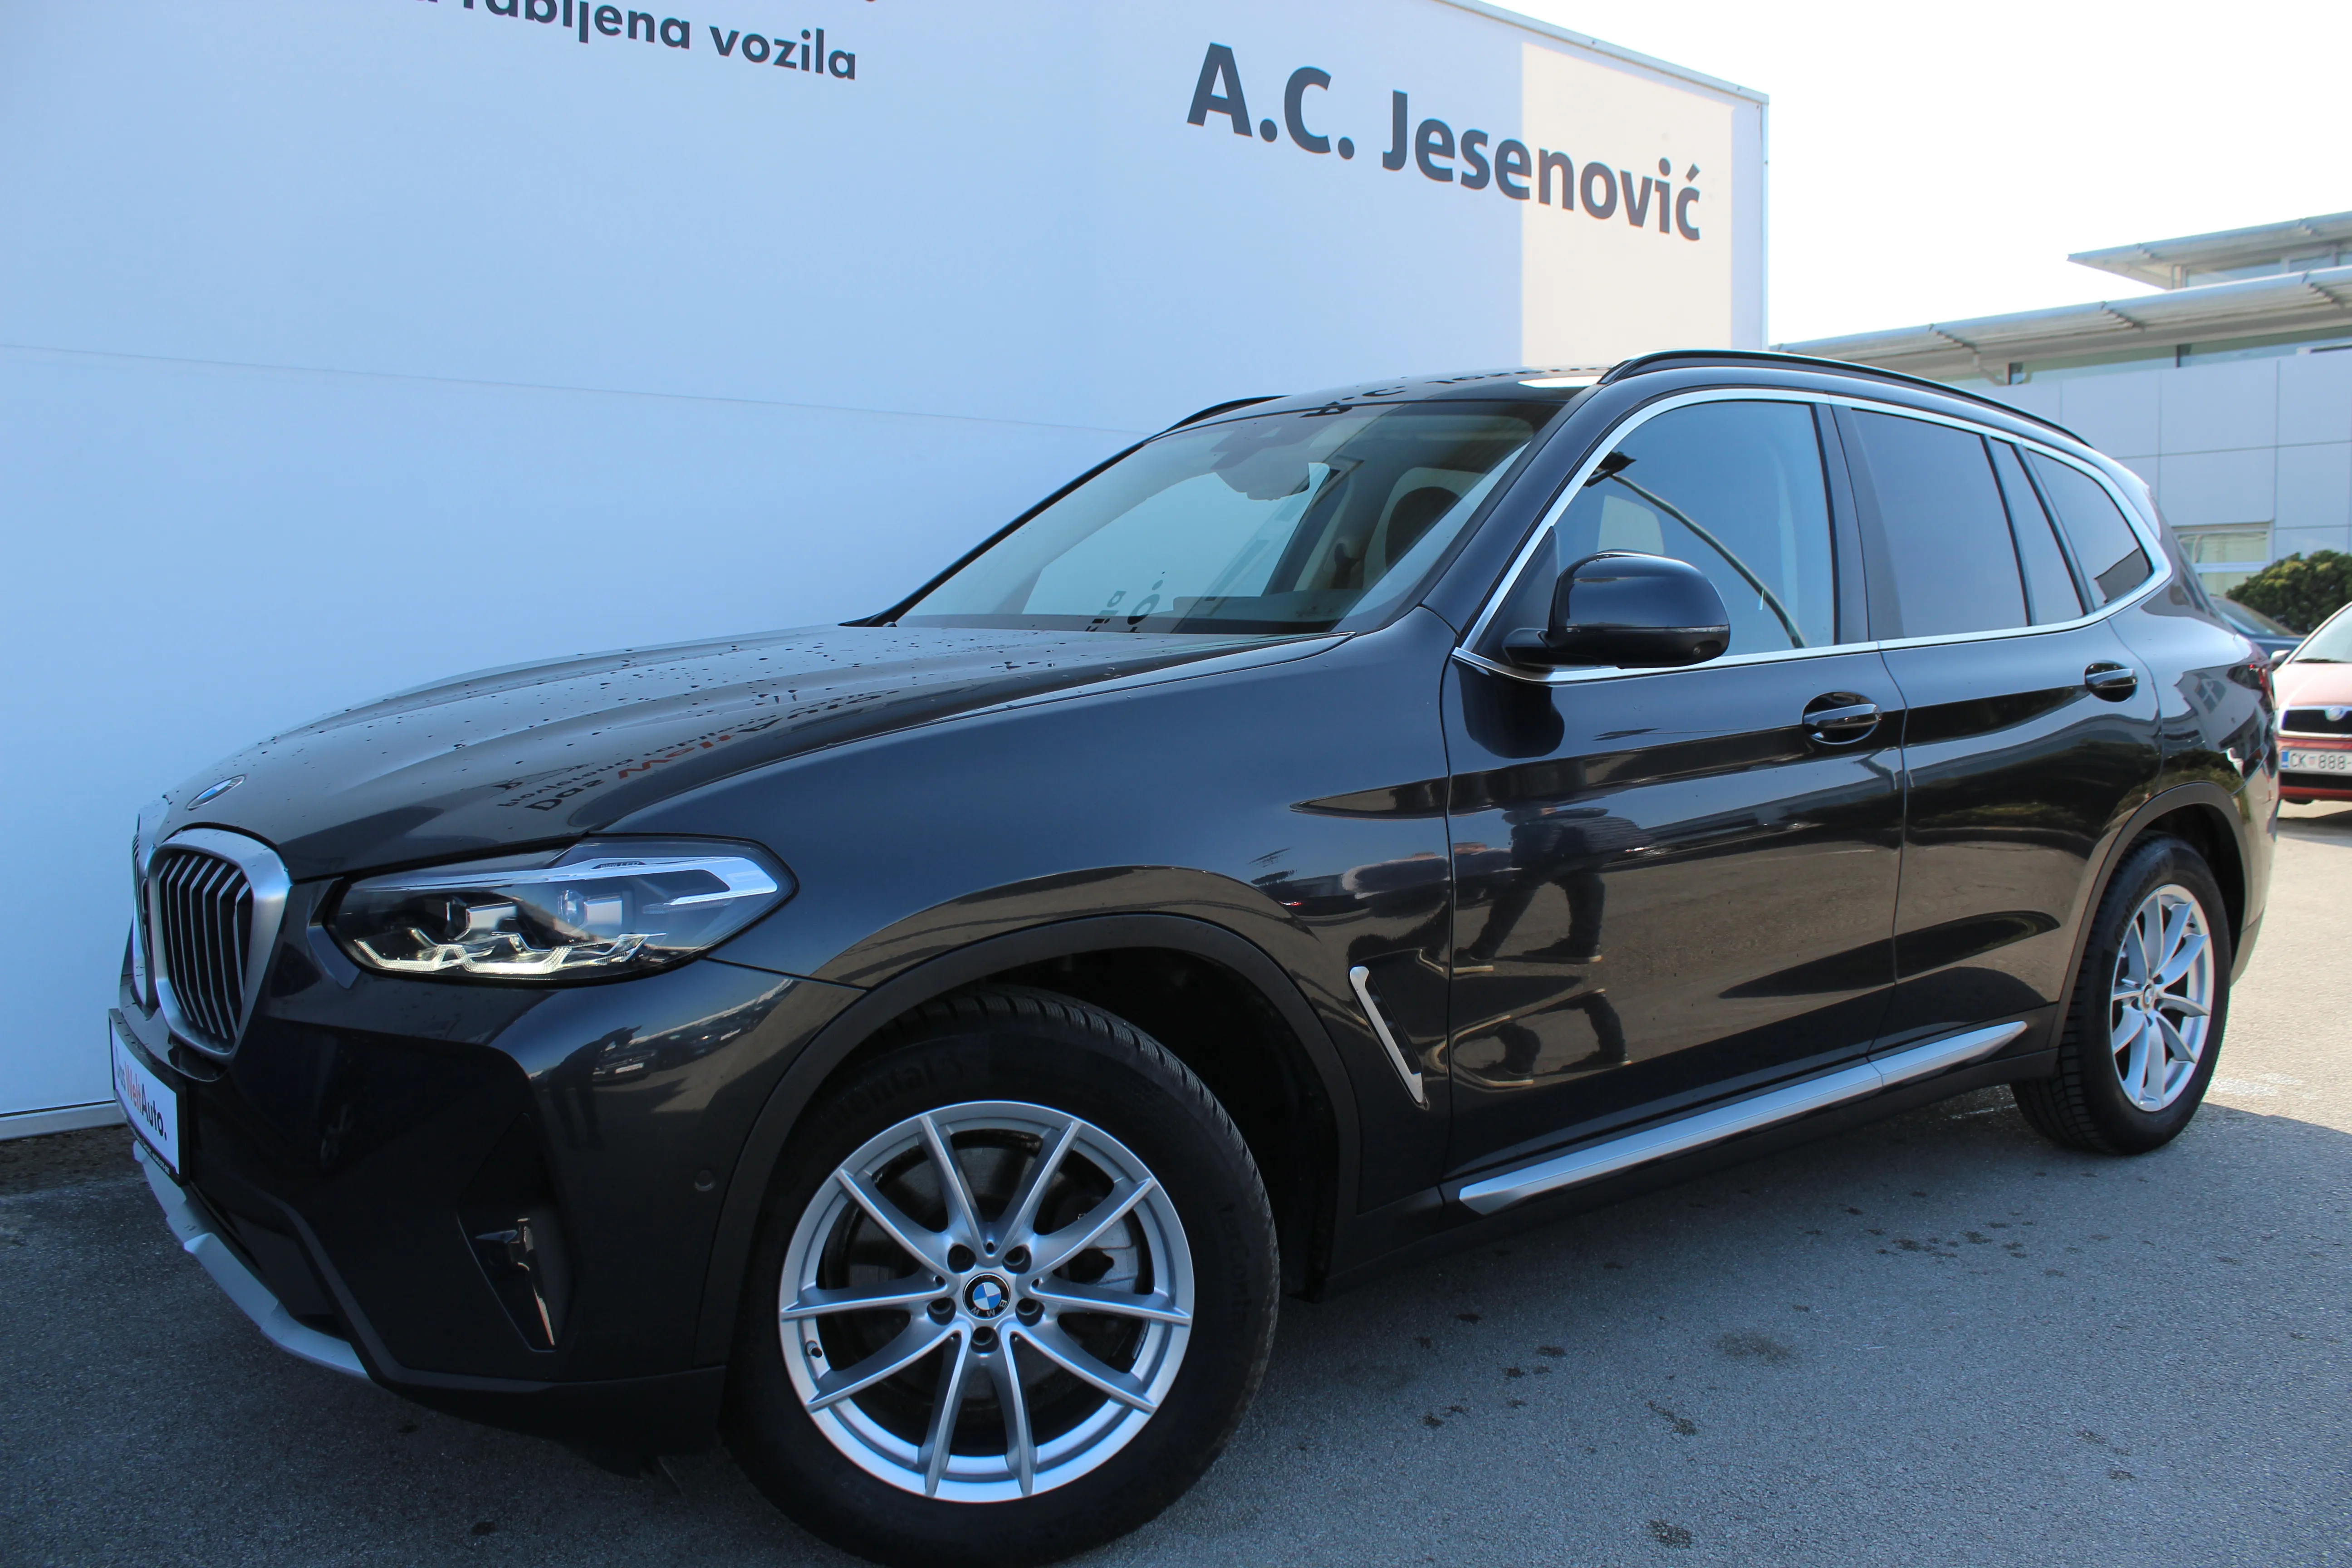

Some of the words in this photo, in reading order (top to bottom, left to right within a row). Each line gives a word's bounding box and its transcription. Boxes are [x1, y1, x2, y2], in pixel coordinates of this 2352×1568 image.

[464, 0, 690, 49] abljena
[709, 26, 856, 80] vozila
[1186, 42, 1355, 160] A.C.
[1382, 89, 1700, 242] Jesenović
[2291, 753, 2308, 768] CK
[970, 1299, 1007, 1317] BMW
